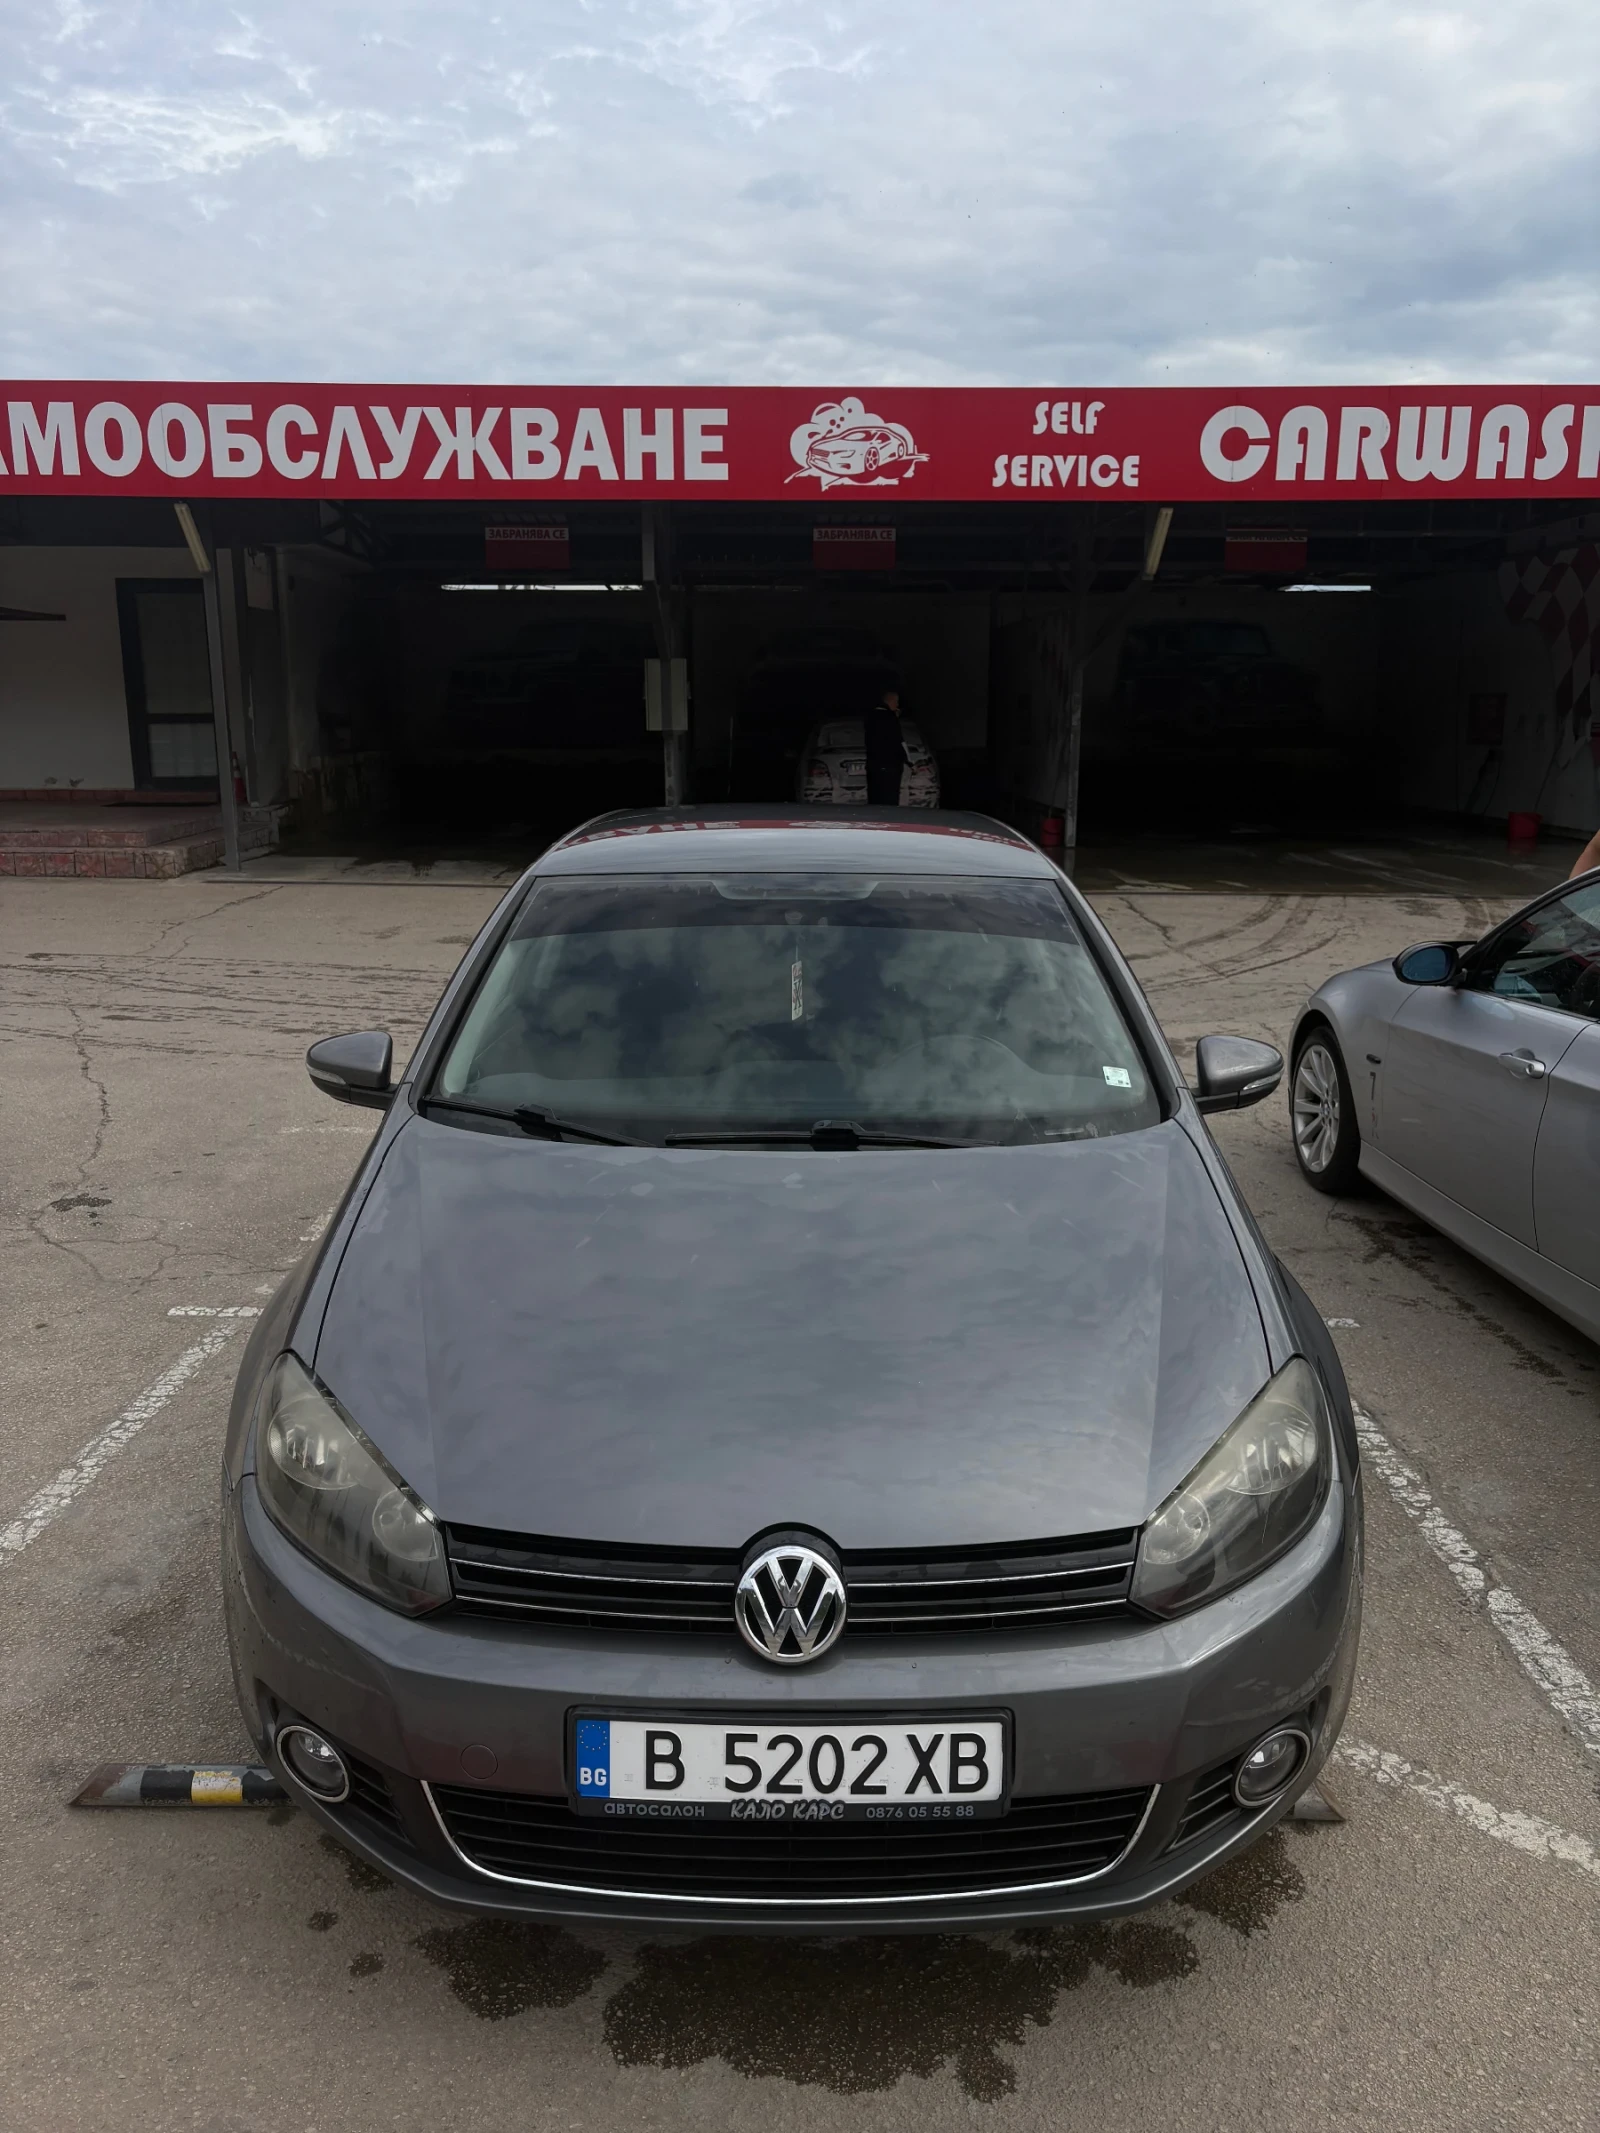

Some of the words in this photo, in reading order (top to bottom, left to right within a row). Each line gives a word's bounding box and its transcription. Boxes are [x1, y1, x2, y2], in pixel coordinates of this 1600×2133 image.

[1032, 401, 1106, 435] SELF
[0, 401, 729, 481] МООБСЛУЖВАНЕ
[992, 454, 1140, 488] SERVICE
[488, 528, 551, 539] ЗАБРАНЯВА
[553, 529, 566, 539] СЕ
[816, 529, 878, 540] ЗАБРАНЯВА
[879, 529, 893, 540] СЕ
[645, 1730, 685, 1790] B
[724, 1733, 888, 1795] 5202
[904, 1733, 989, 1795] XB
[579, 1767, 607, 1786] BG
[730, 1802, 785, 1820] КАЛО
[792, 1803, 845, 1820] КАРС
[866, 1807, 903, 1818] 0876
[908, 1806, 927, 1818] 05
[932, 1806, 951, 1817] 55
[955, 1805, 974, 1817] 88
